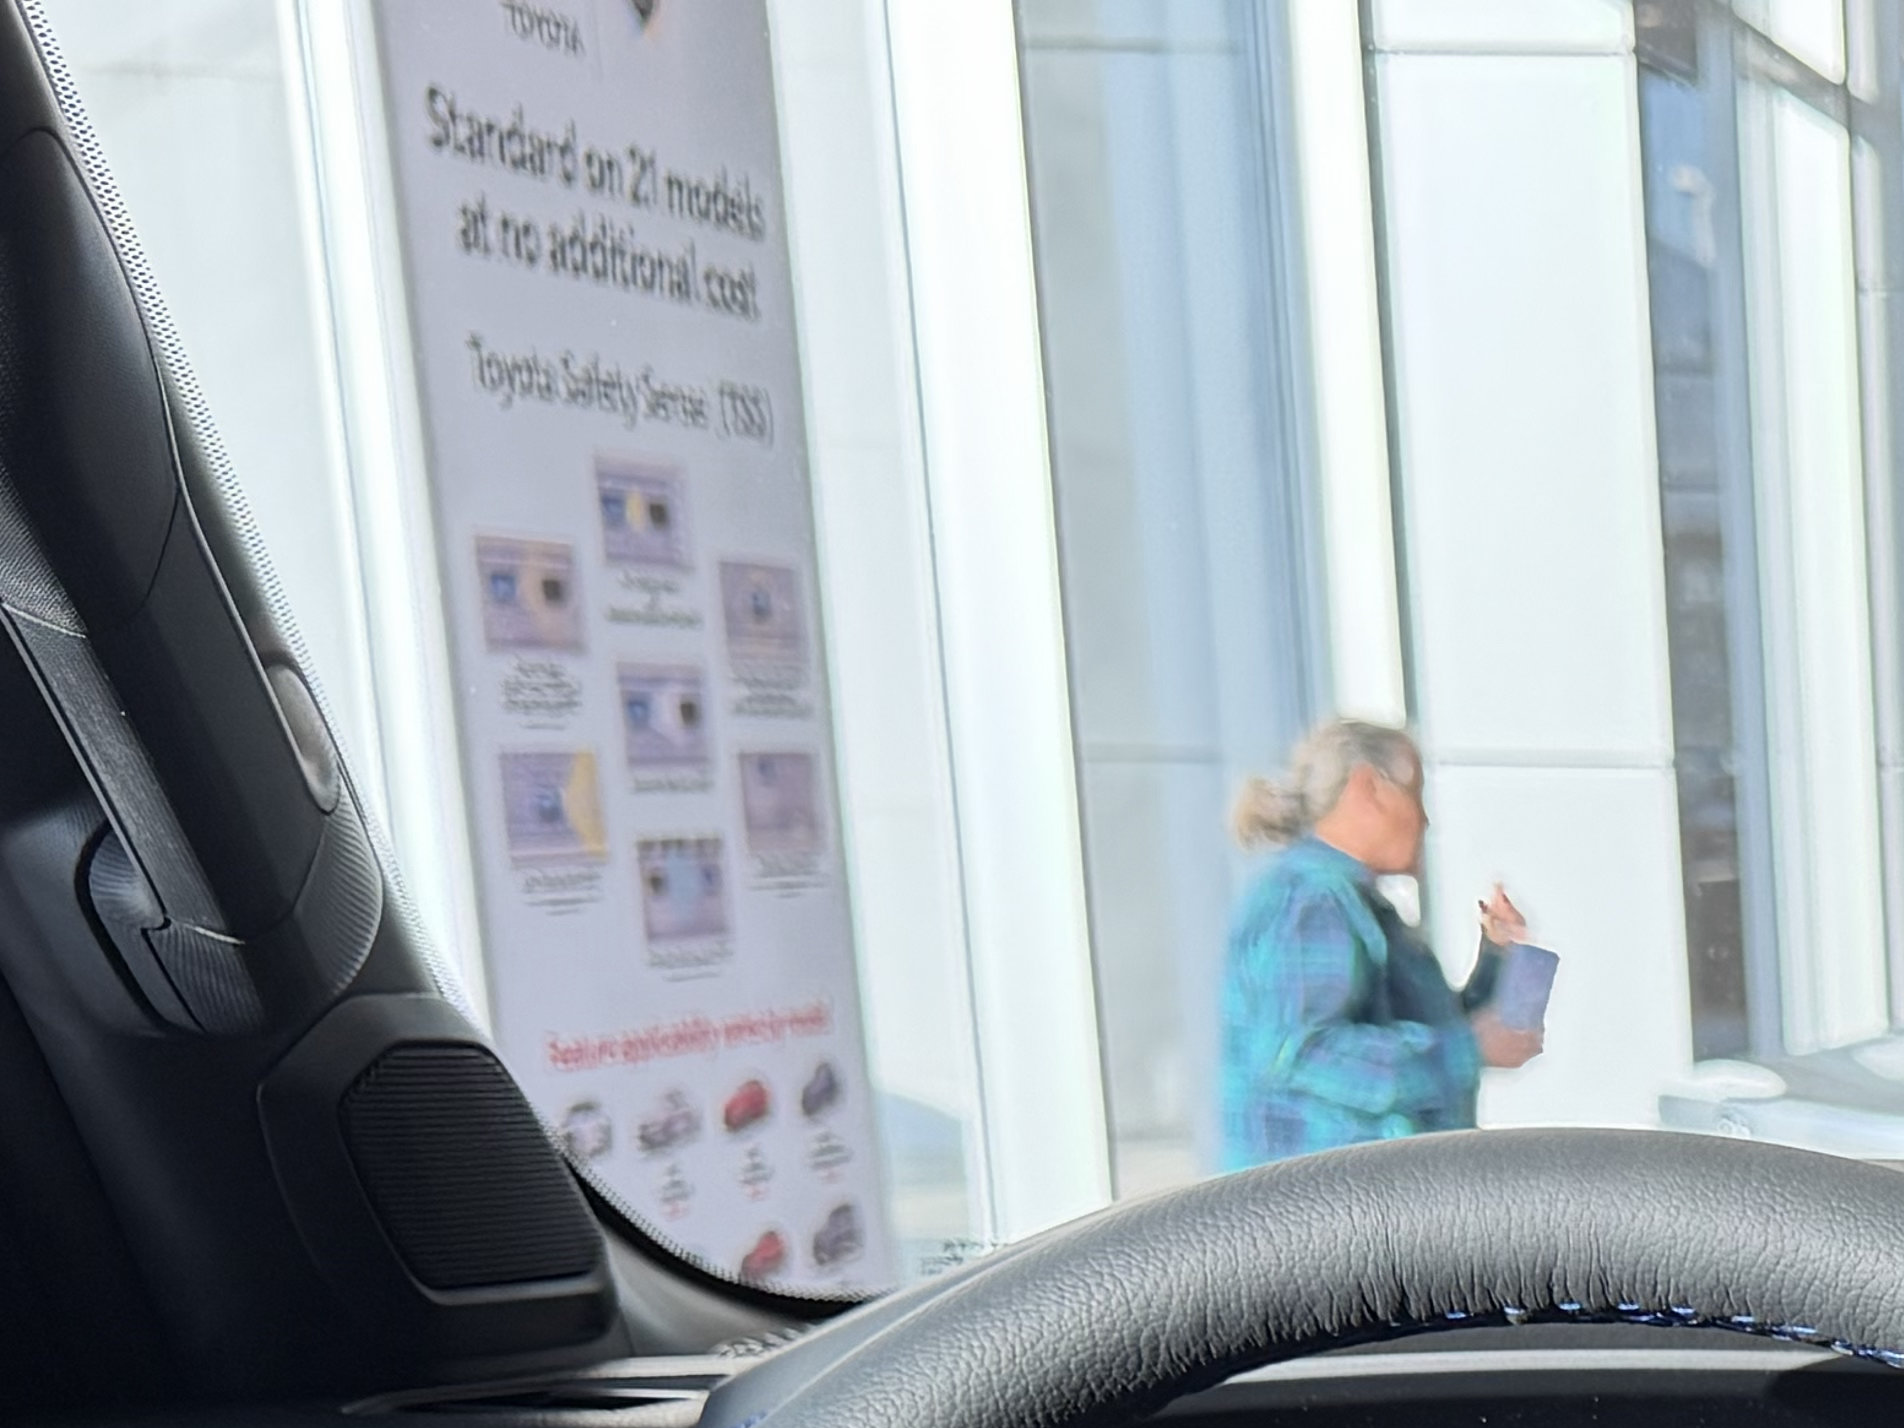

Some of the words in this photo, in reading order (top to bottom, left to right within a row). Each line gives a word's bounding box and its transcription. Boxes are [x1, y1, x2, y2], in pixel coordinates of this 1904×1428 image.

[424, 82, 578, 190] Standard
[582, 147, 624, 197] on
[627, 144, 657, 207] 21
[664, 165, 764, 242] models
[459, 192, 488, 255] at
[500, 209, 541, 268] no
[547, 208, 699, 303] additional
[703, 260, 759, 319] cost
[467, 330, 558, 411] Toyota
[559, 350, 640, 431] Safety
